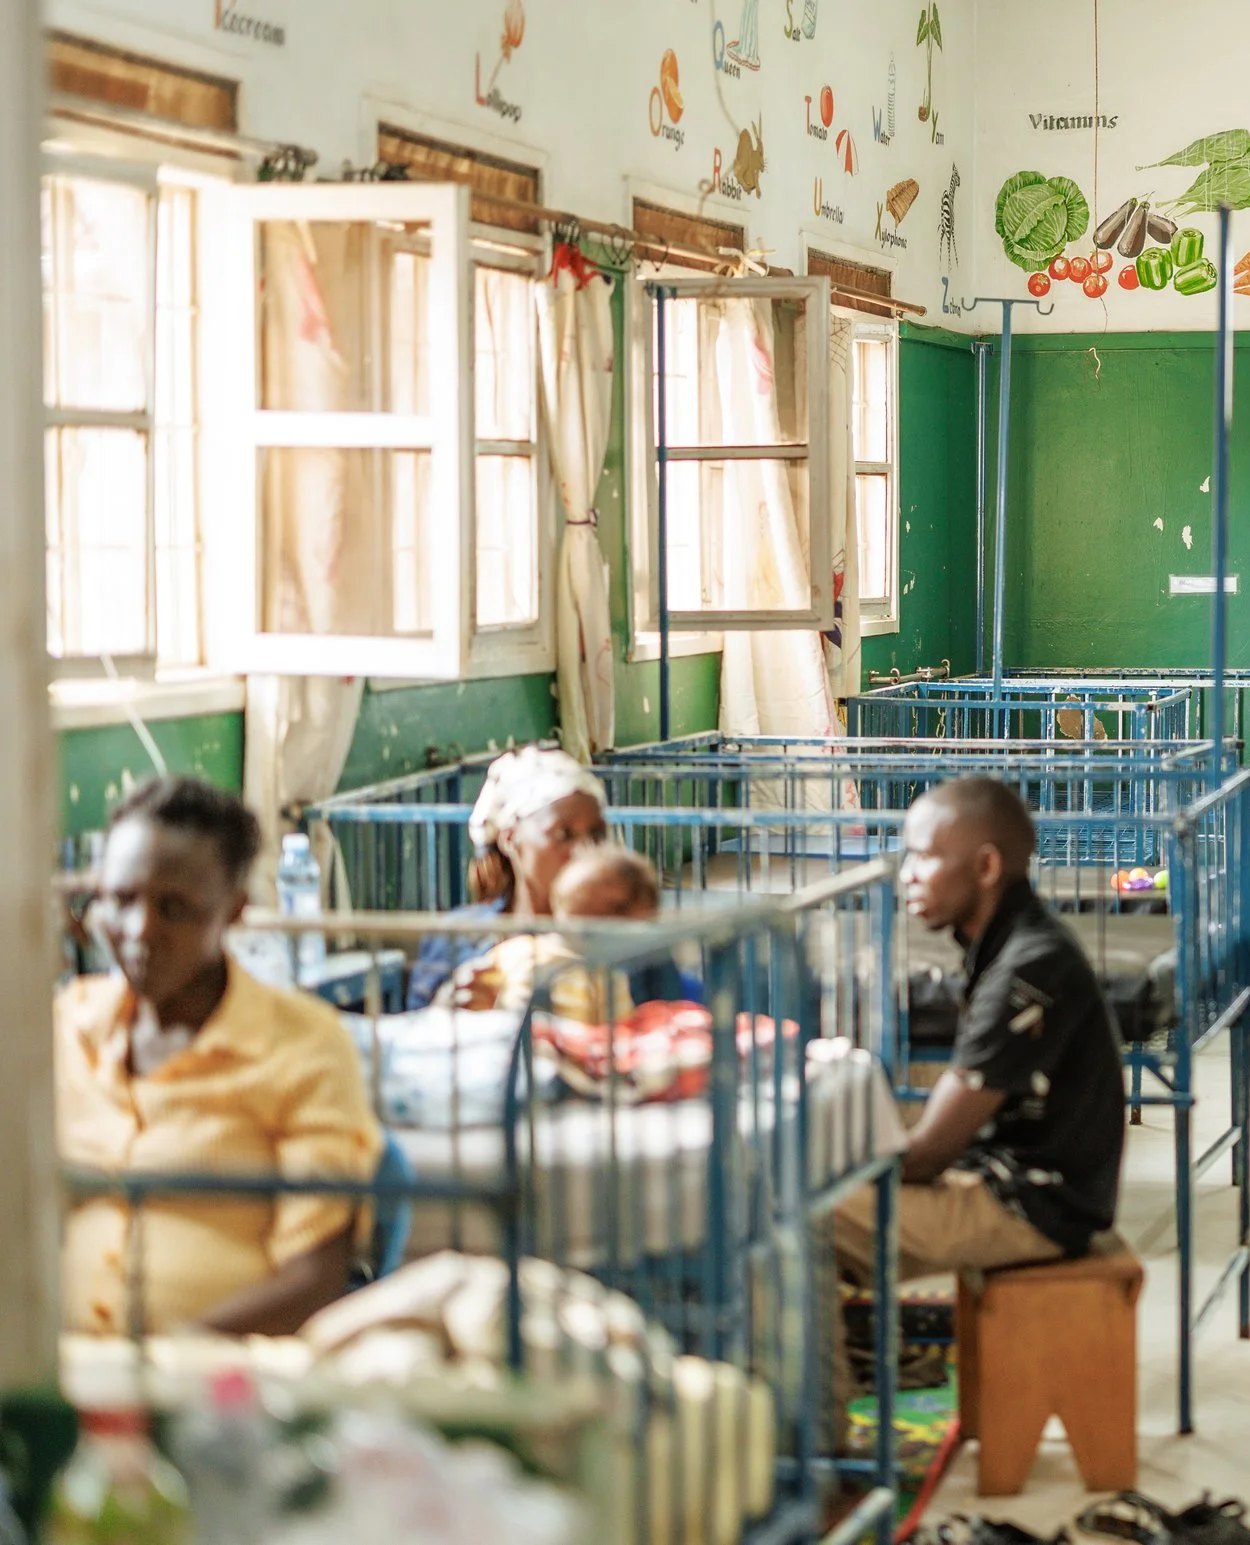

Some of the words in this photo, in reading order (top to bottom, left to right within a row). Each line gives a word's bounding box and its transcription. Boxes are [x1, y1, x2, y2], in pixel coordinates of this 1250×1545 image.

[713, 20, 741, 80] Queen
[649, 86, 684, 151] Orange
[804, 95, 828, 141] Tomato
[872, 105, 891, 146] Water
[931, 108, 945, 145] Yam
[1028, 112, 1119, 131] Vitamins
[713, 146, 742, 200] Rabbit
[814, 176, 844, 225] Umbrella
[874, 201, 907, 249] Xylophone
